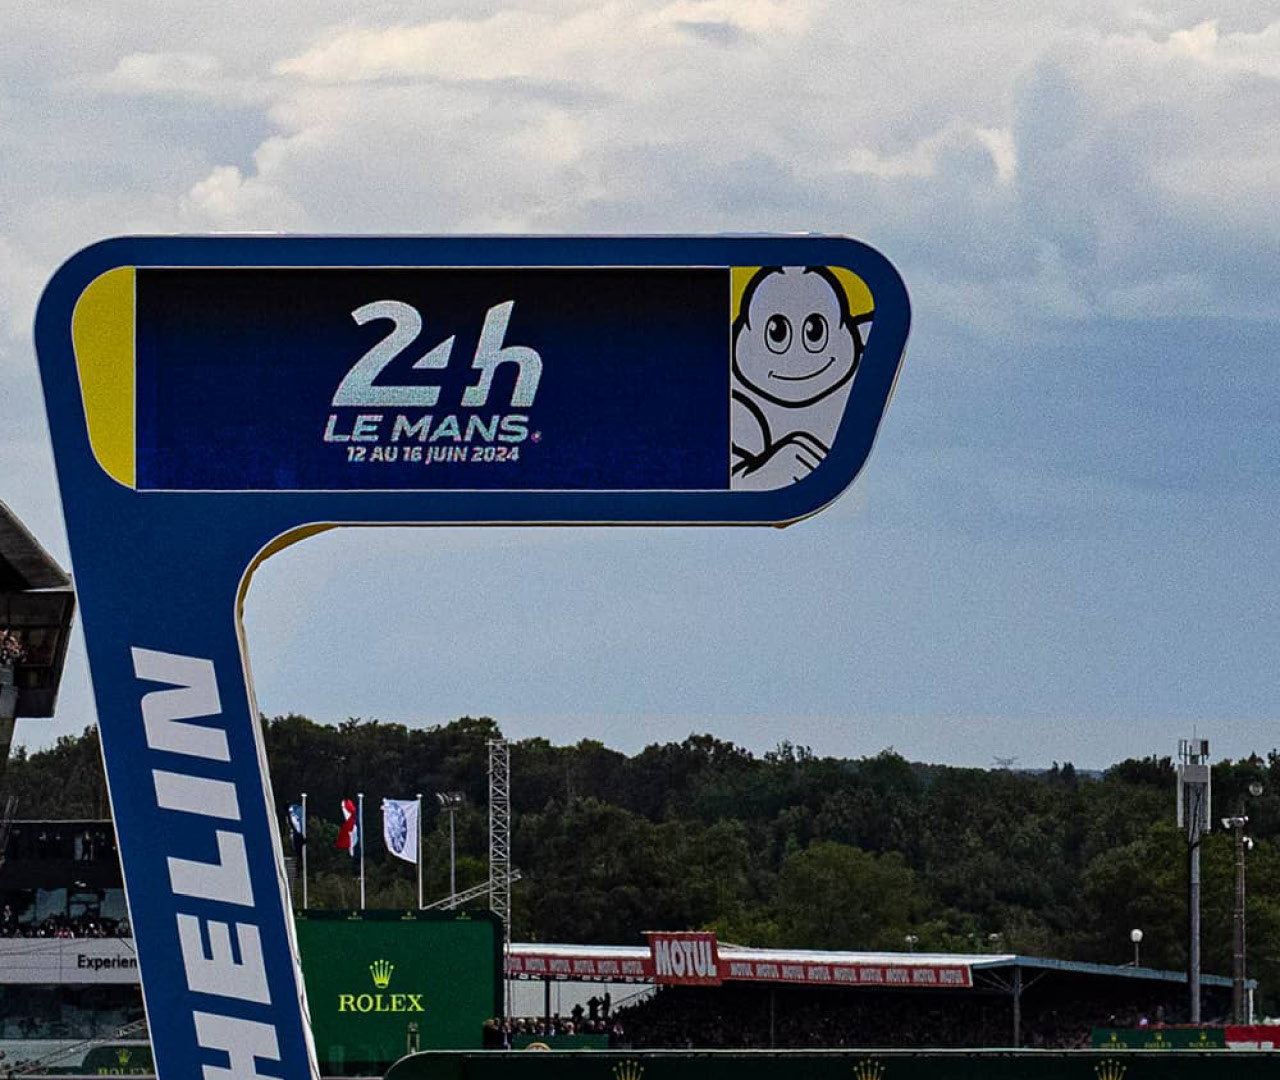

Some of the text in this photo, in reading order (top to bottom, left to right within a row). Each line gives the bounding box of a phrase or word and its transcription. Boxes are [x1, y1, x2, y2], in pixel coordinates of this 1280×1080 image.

[331, 299, 543, 407] 24h
[323, 414, 531, 443] LE MANS
[347, 446, 520, 465] 12 AU 16 JUIN 2024
[77, 954, 138, 971] Experien
[654, 939, 718, 978] MOTUL
[340, 994, 425, 1012] ROLEX
